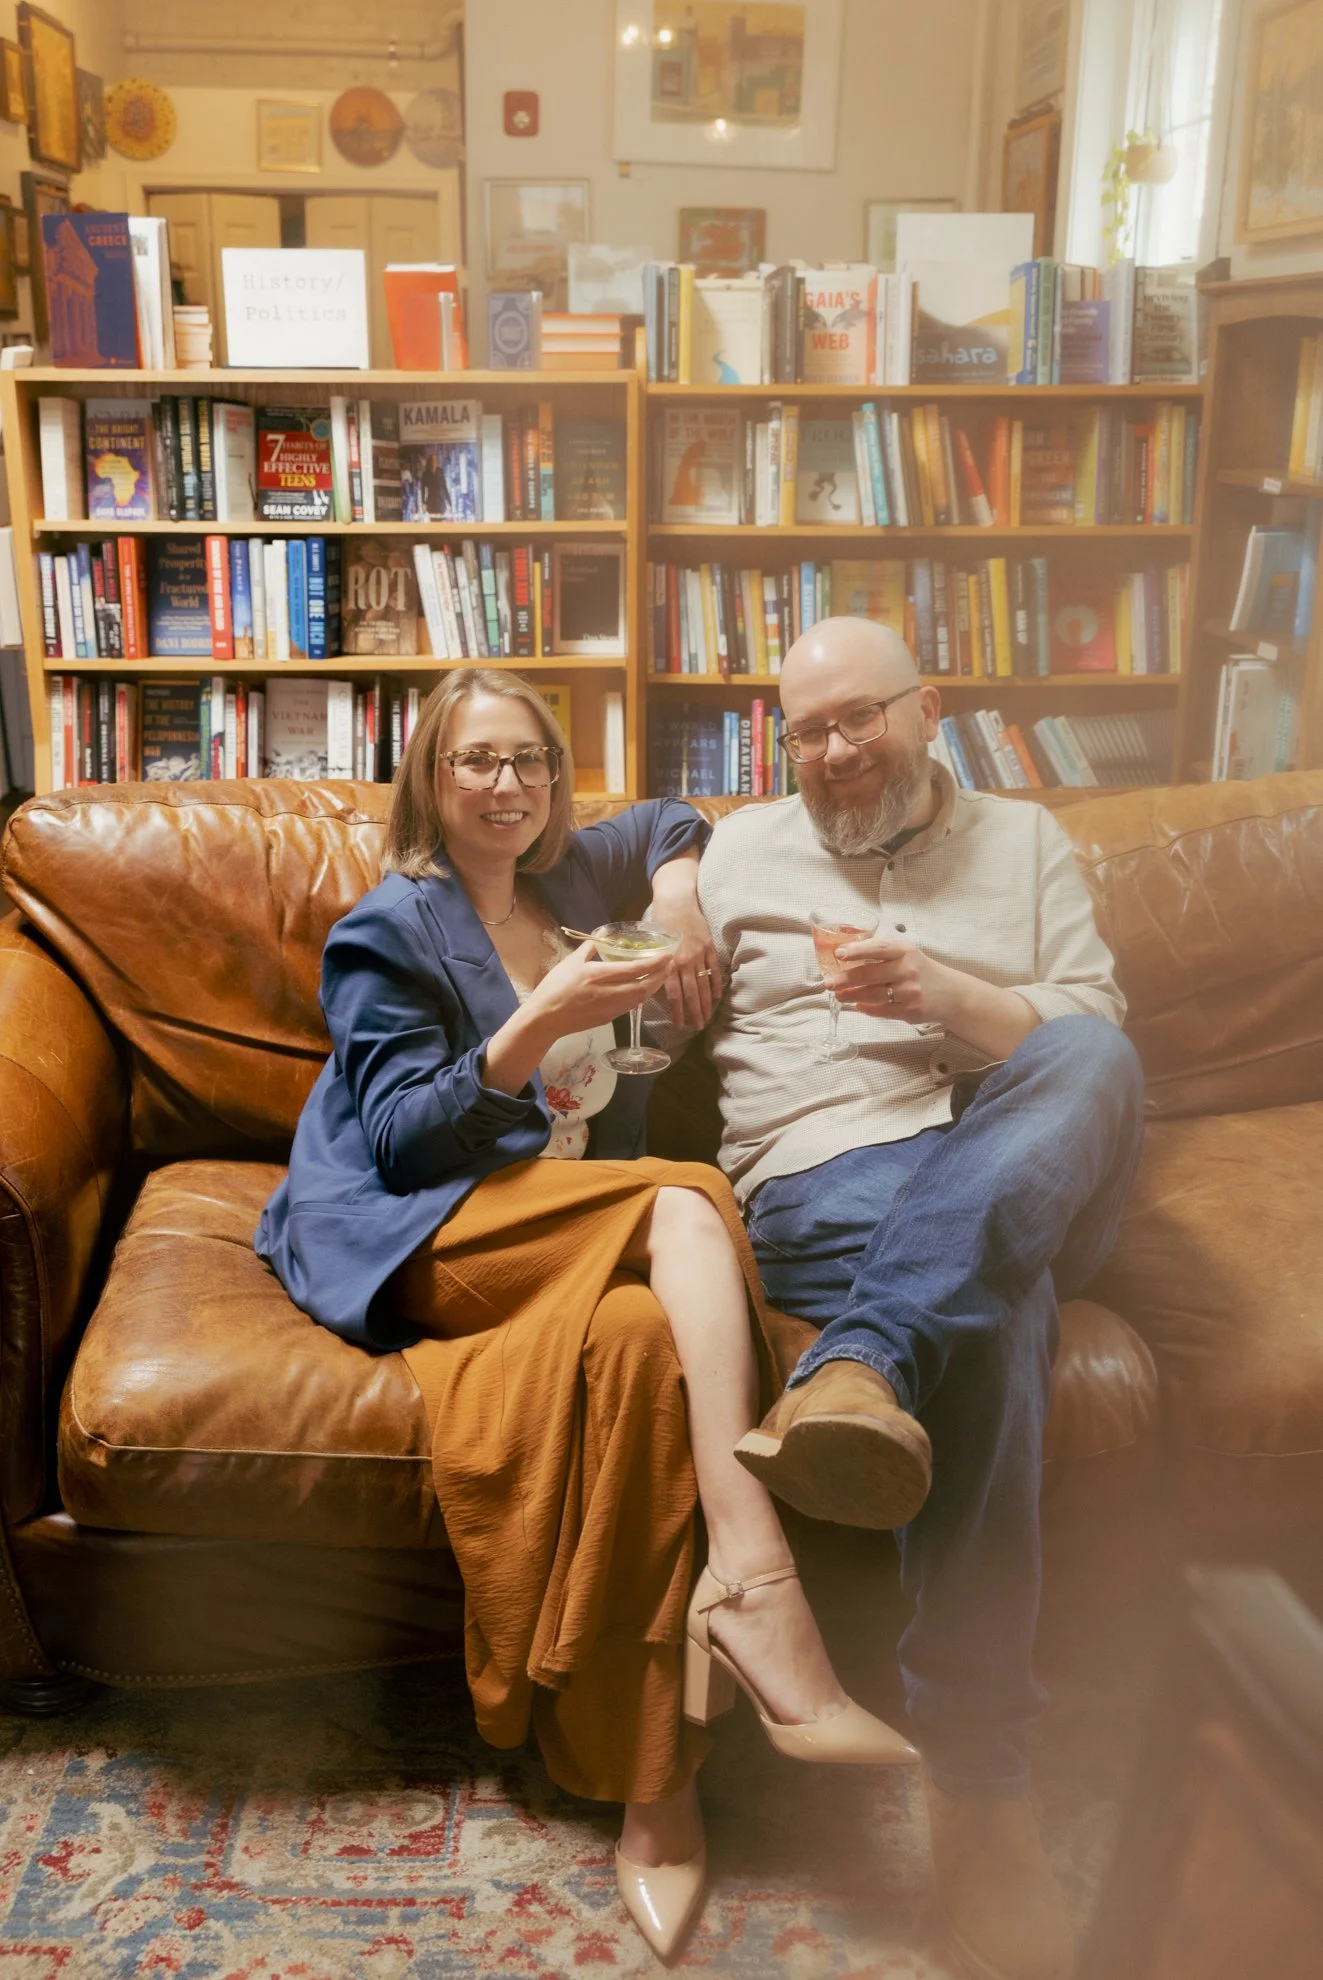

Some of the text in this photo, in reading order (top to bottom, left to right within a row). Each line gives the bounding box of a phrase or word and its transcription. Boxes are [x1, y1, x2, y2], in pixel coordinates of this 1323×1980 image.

[88, 235, 129, 247] GREECE
[243, 272, 345, 294] History/
[804, 291, 861, 309] GAIA'S
[246, 304, 347, 321] Politics
[812, 333, 849, 350] WEB
[403, 406, 470, 425] KAMALA
[88, 436, 145, 449] CONTINENT
[266, 434, 286, 462] 7
[282, 441, 315, 450] HABITS
[280, 453, 318, 462] HIGHLY
[264, 462, 330, 473] EFFECTIVE
[279, 474, 316, 487] TEENS
[263, 505, 328, 516] SEAN COVEY
[347, 566, 412, 611] ROT
[170, 595, 199, 608] World
[308, 577, 325, 646] NOT ONE INCH
[288, 727, 314, 736] WAR
